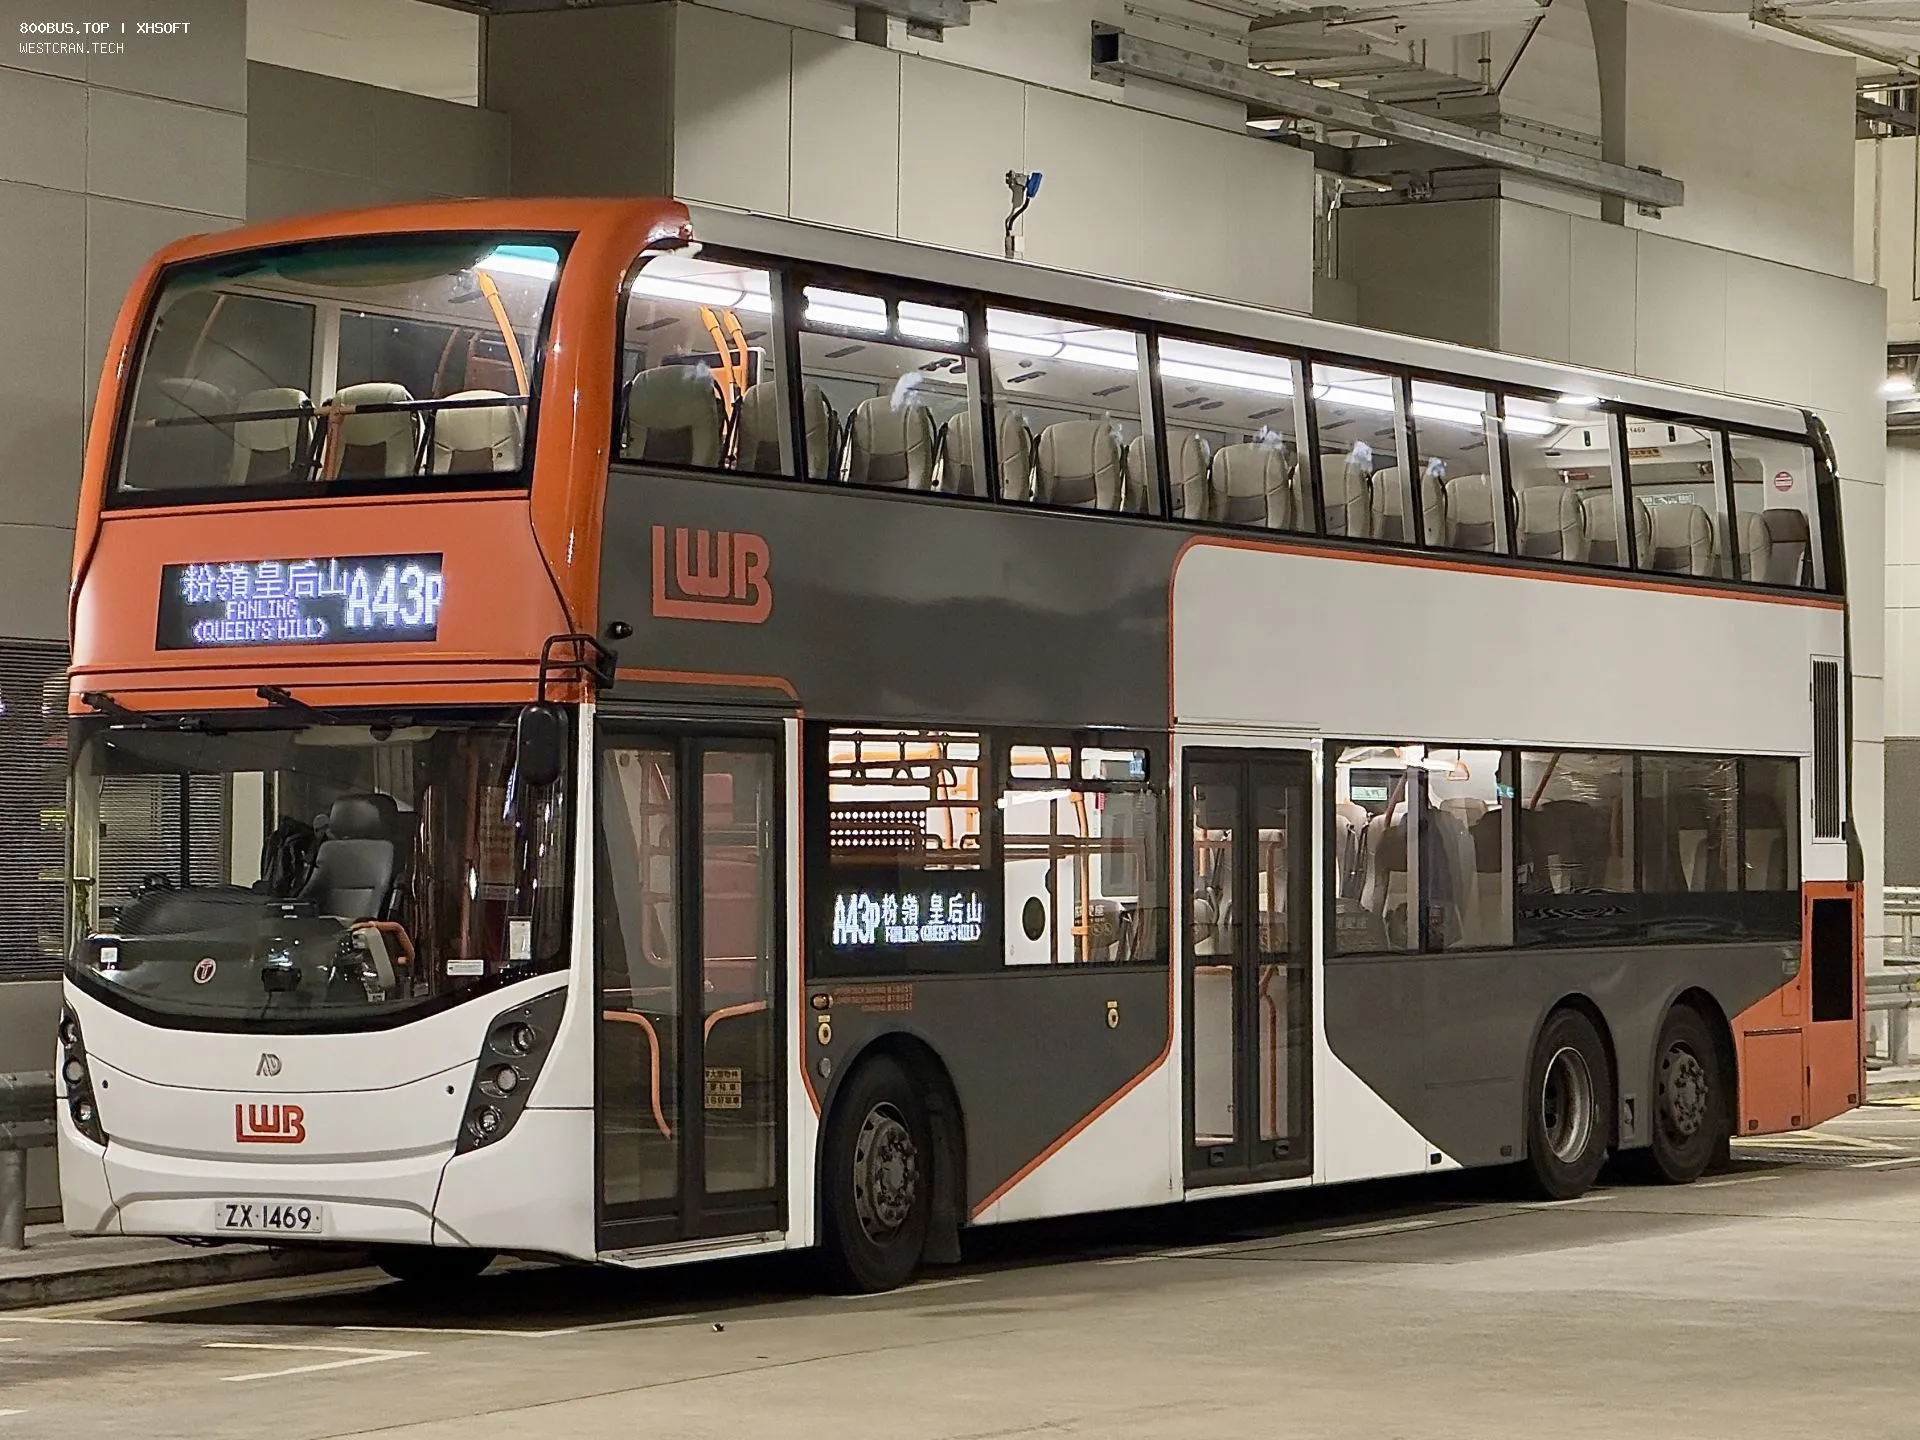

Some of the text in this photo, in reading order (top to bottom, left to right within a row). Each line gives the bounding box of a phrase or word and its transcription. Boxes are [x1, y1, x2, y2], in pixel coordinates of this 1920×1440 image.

[652, 525, 773, 624] LWB
[226, 599, 298, 621] FANLING
[346, 564, 443, 627] A43P
[235, 1104, 306, 1144] LWB
[225, 1204, 312, 1230] ZX 1469
